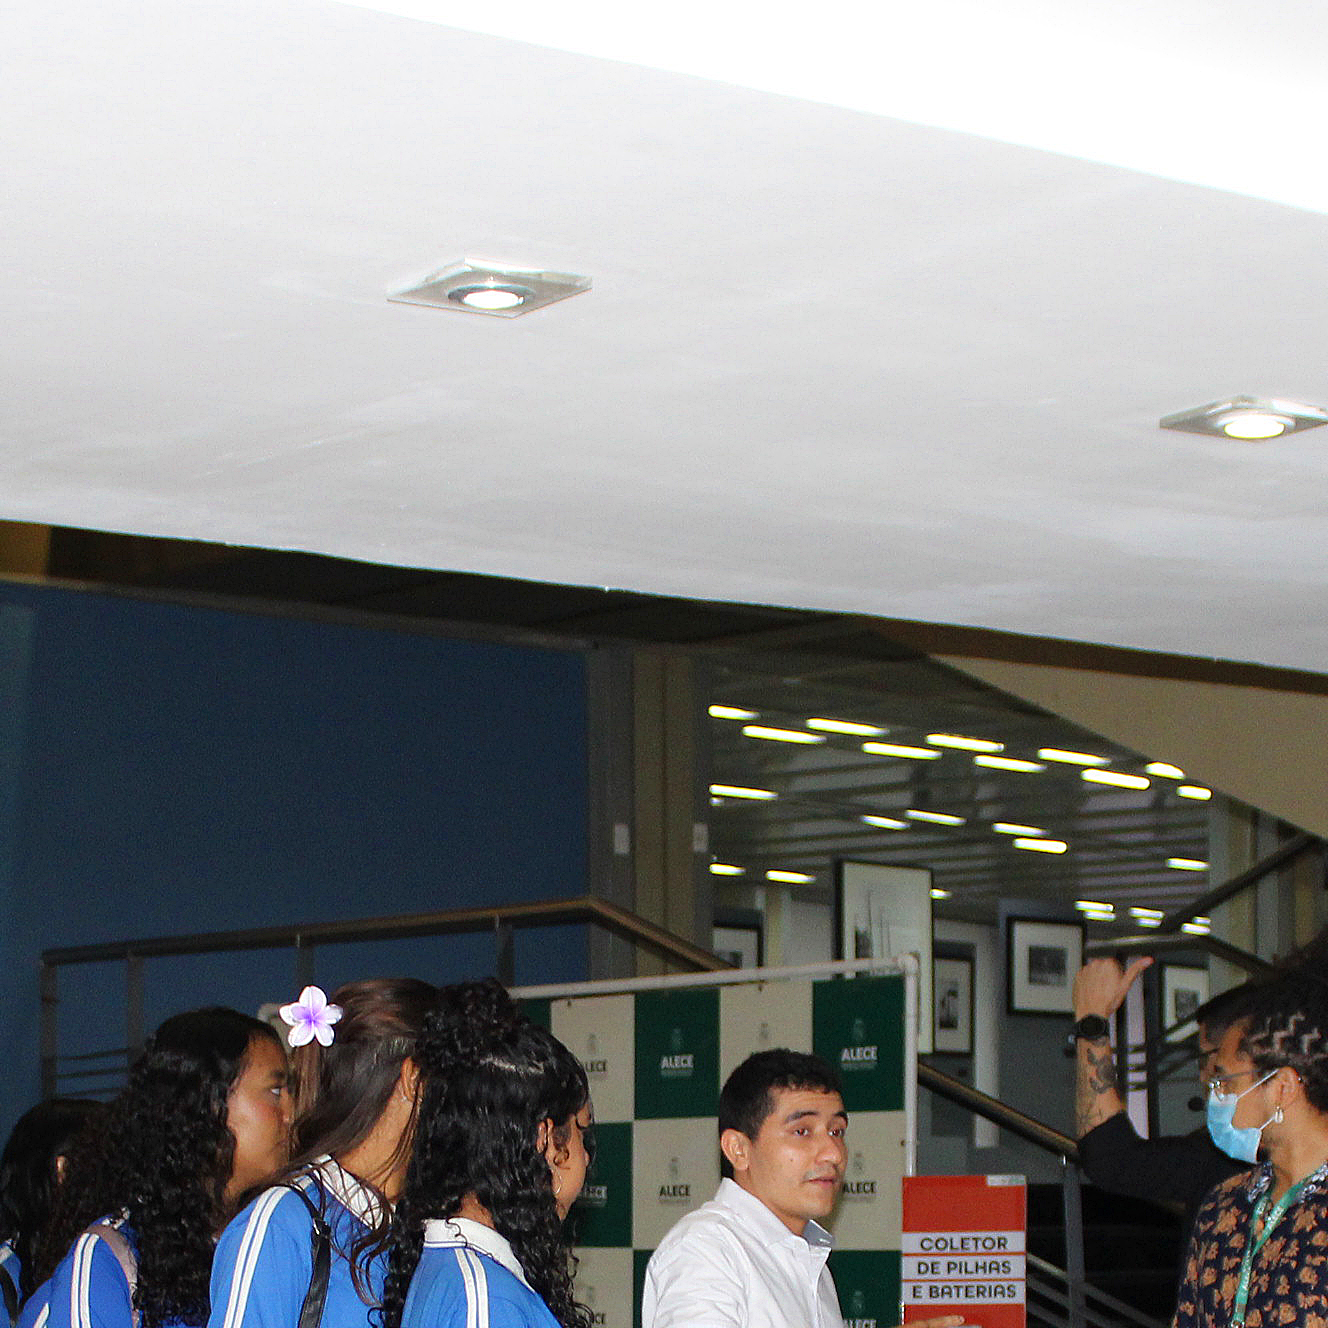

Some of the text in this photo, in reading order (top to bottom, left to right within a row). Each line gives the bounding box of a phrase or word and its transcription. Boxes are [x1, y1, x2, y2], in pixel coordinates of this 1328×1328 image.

[840, 1046, 878, 1061] ALECE
[584, 1060, 608, 1072] LECE
[660, 1054, 694, 1069] ALECE
[659, 1184, 691, 1197] ALECE
[842, 1182, 877, 1194] ALECE
[920, 1237, 1008, 1251] COLETOR
[917, 1260, 1012, 1275] DE PILHAS
[913, 1284, 1016, 1299] E BATERIAS
